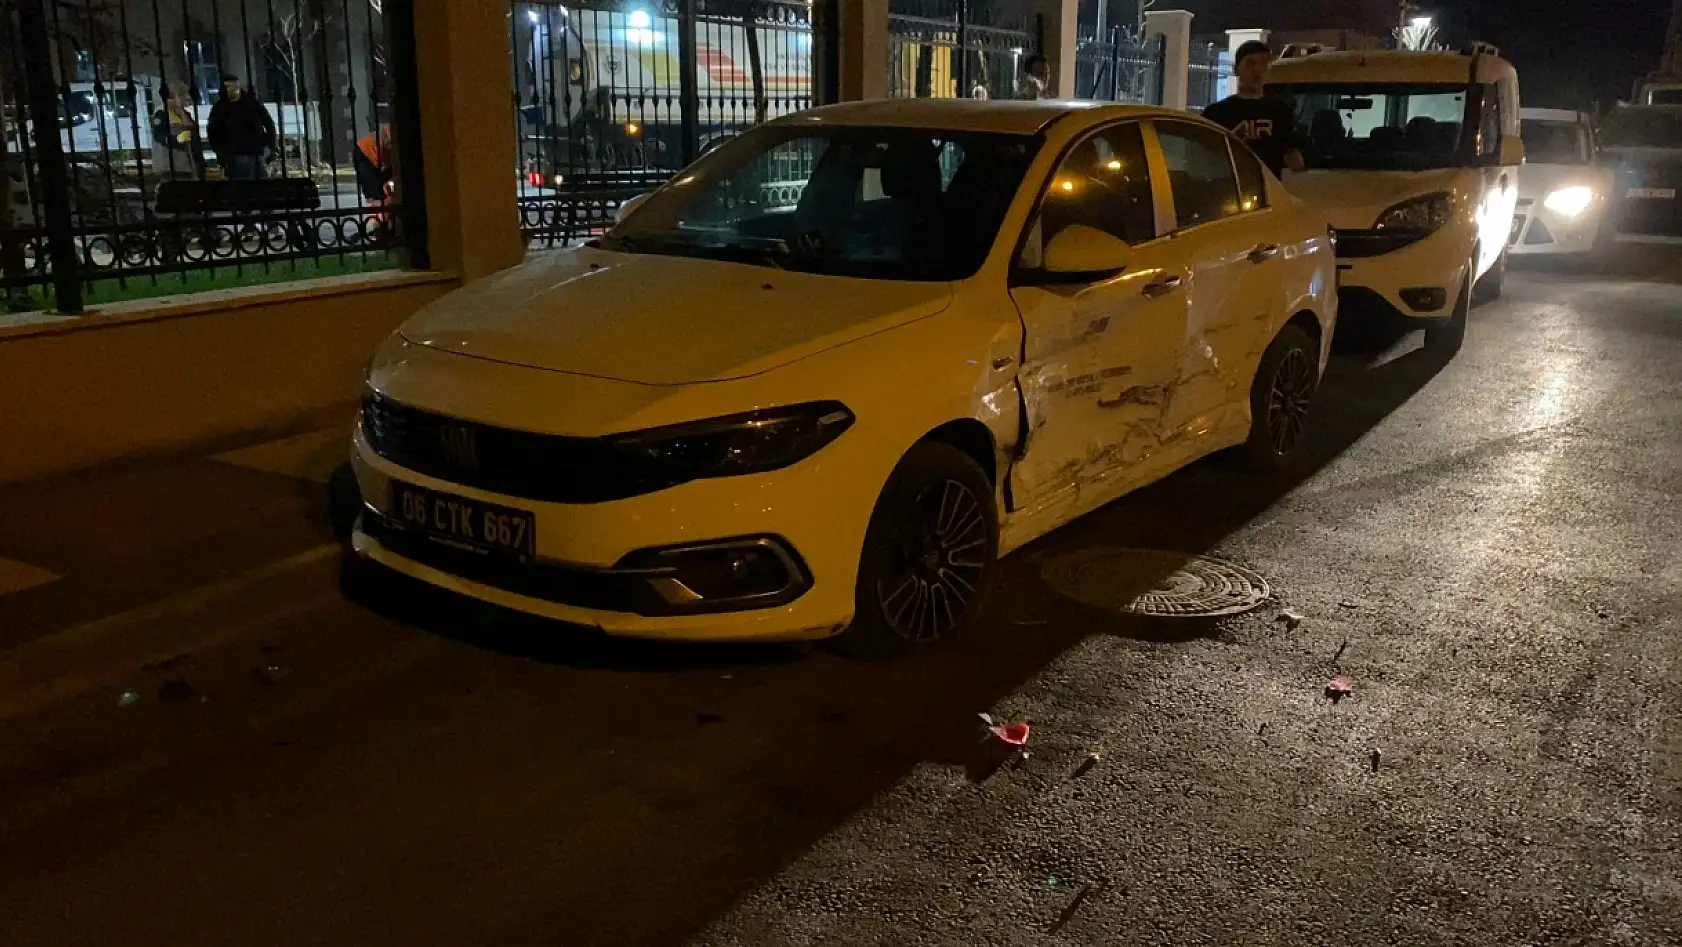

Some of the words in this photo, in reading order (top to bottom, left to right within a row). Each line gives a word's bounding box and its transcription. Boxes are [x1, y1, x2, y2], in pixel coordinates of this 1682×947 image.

[403, 491, 427, 524] 06
[434, 499, 475, 538] CTK
[484, 511, 526, 549] 667
